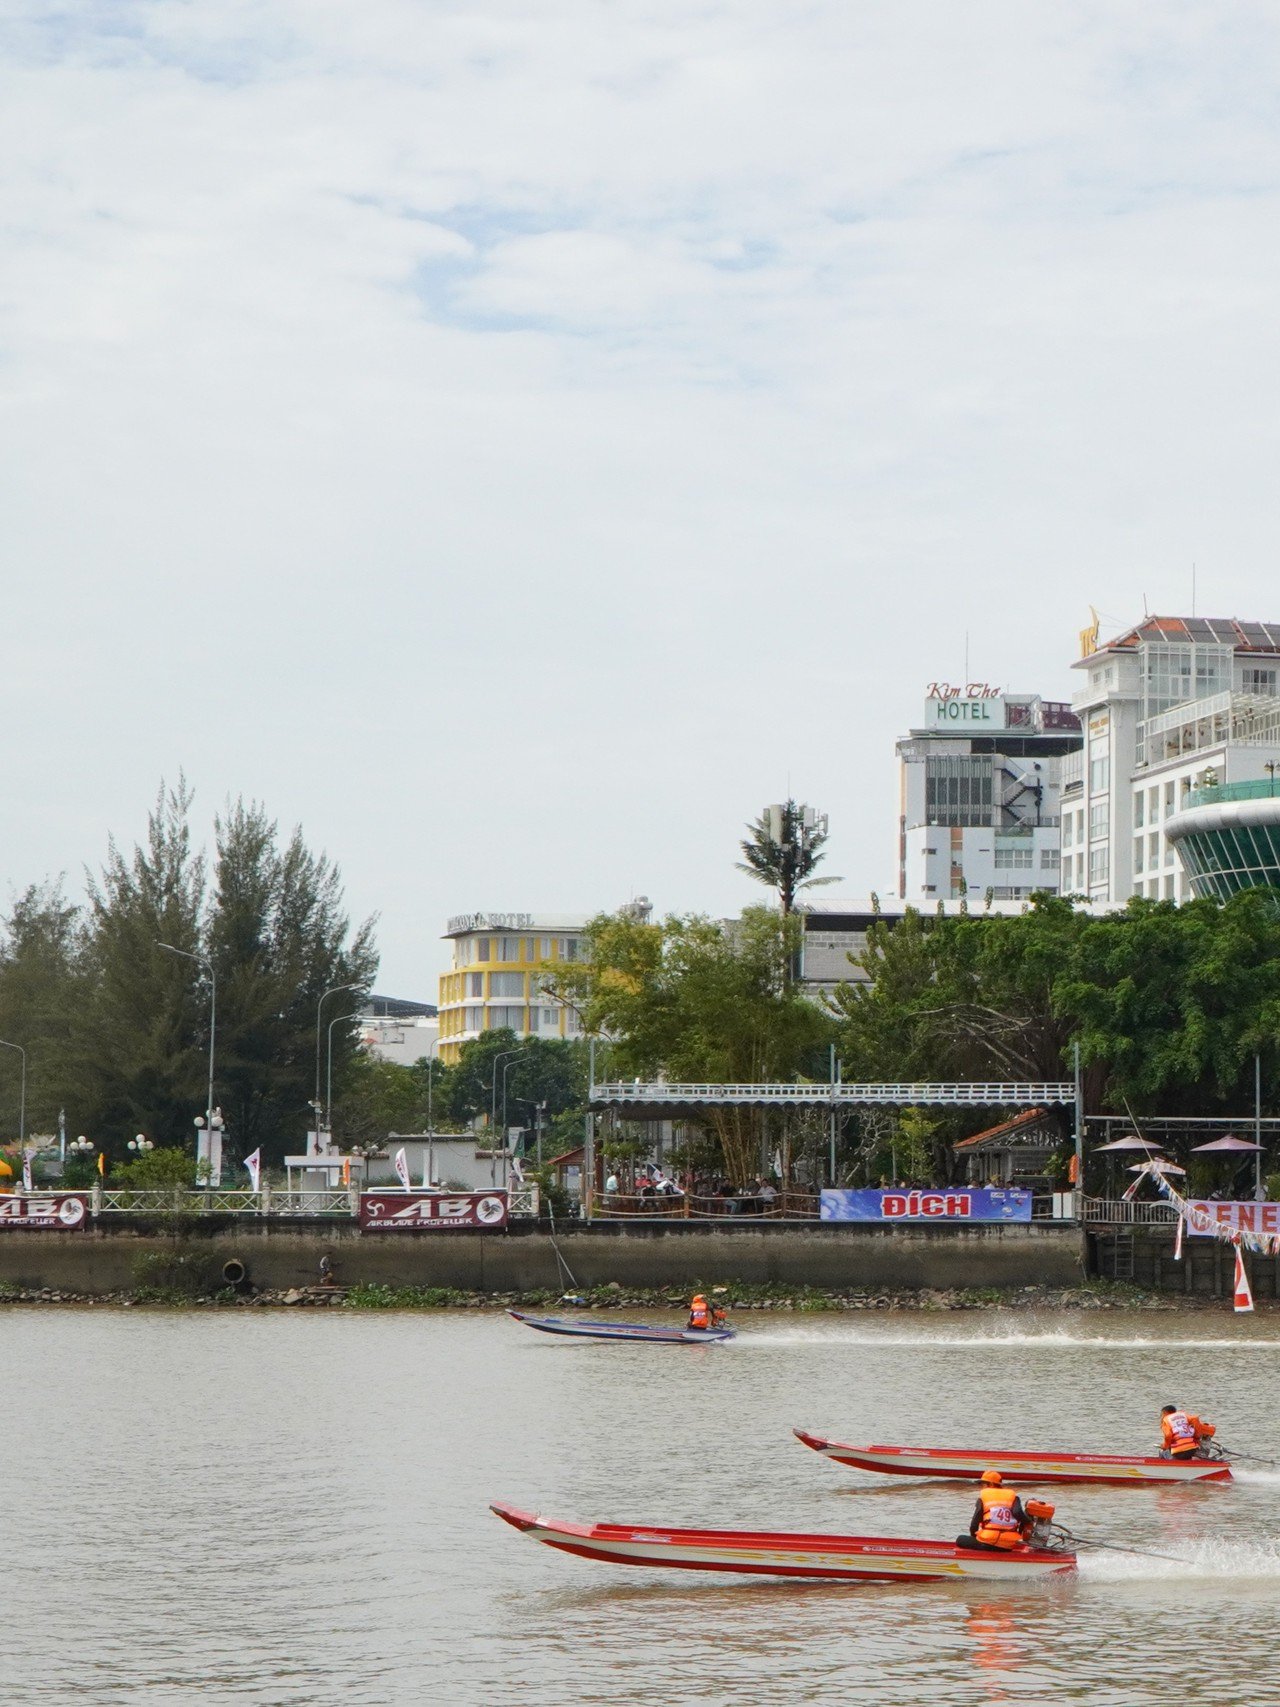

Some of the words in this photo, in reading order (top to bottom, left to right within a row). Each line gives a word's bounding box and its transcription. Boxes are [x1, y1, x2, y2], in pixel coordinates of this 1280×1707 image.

[937, 702, 990, 720] HOTEL
[391, 1199, 473, 1217] AB
[881, 1191, 971, 1217] ĐÍCH
[366, 1218, 413, 1227] AIRBLADE
[416, 1217, 473, 1226] PROPELLER
[997, 1509, 1011, 1523] 49
